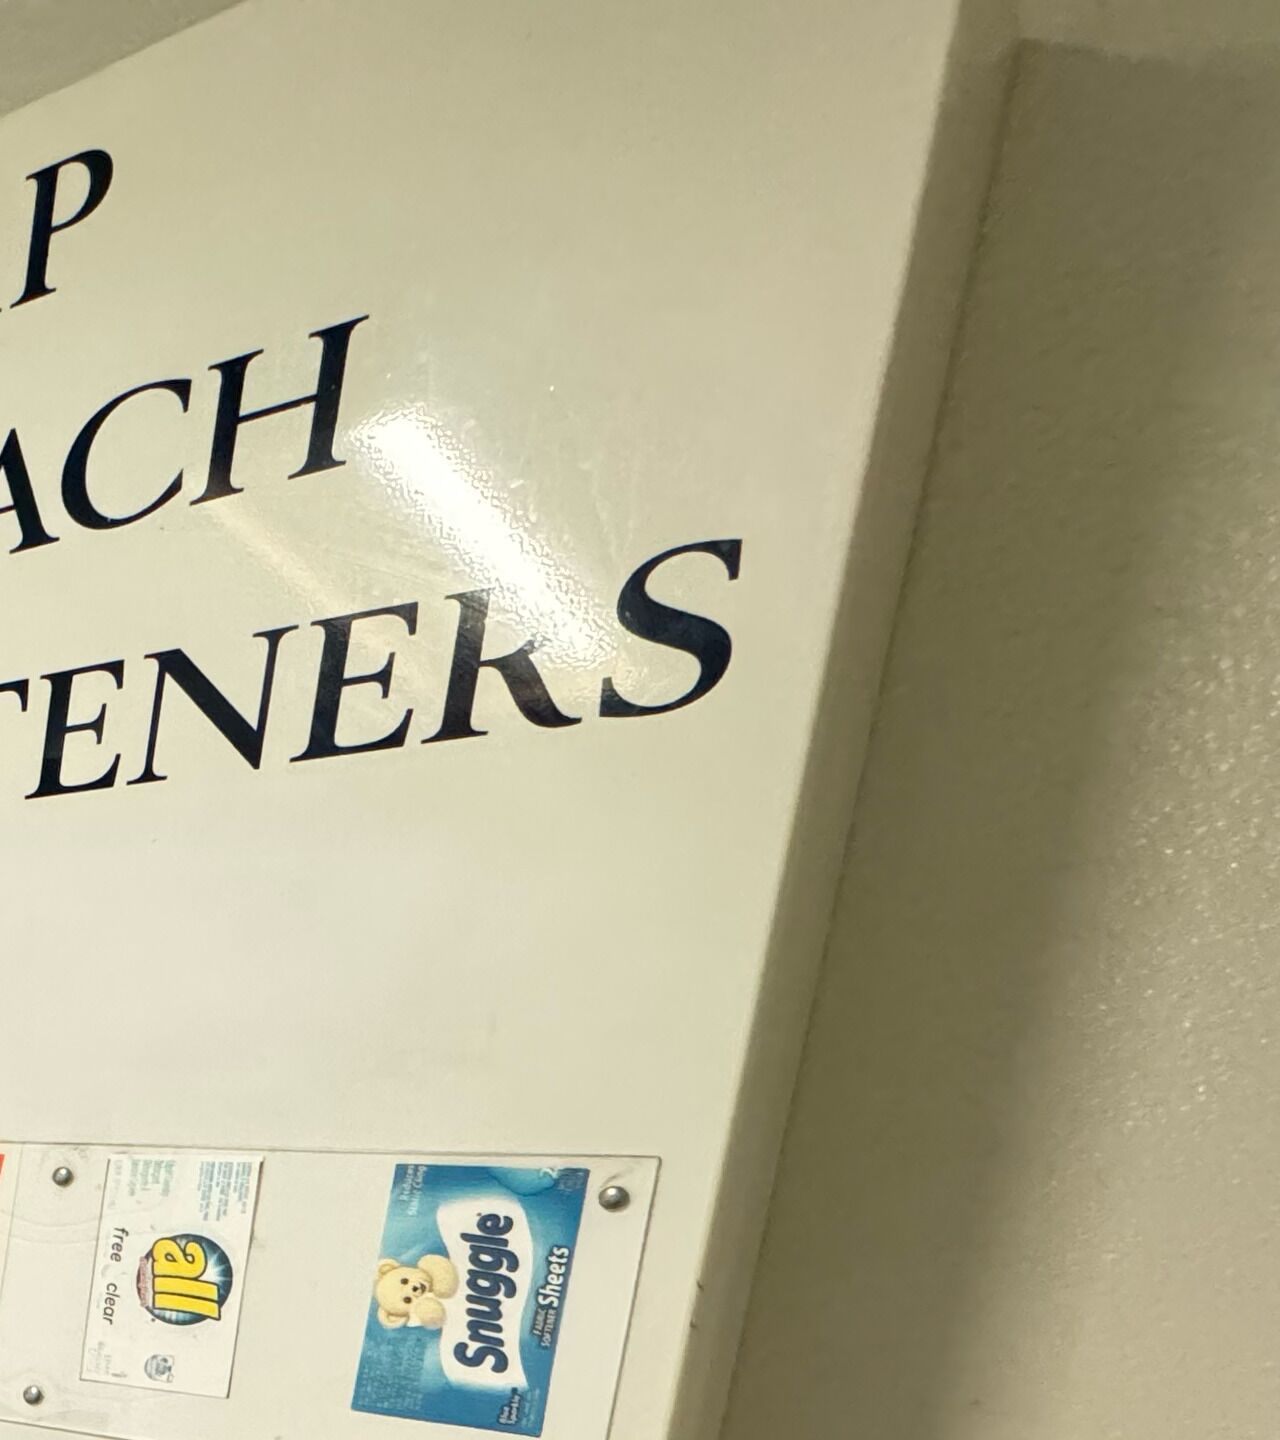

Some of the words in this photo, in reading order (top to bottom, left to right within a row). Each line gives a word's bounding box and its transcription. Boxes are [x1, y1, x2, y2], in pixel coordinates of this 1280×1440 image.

[400, 1165, 415, 1201] Reduces
[110, 1226, 129, 1262] free
[152, 1237, 221, 1320] all
[453, 1213, 520, 1374] Snuggle
[537, 1246, 570, 1308] Sheets
[102, 1282, 121, 1326] clear
